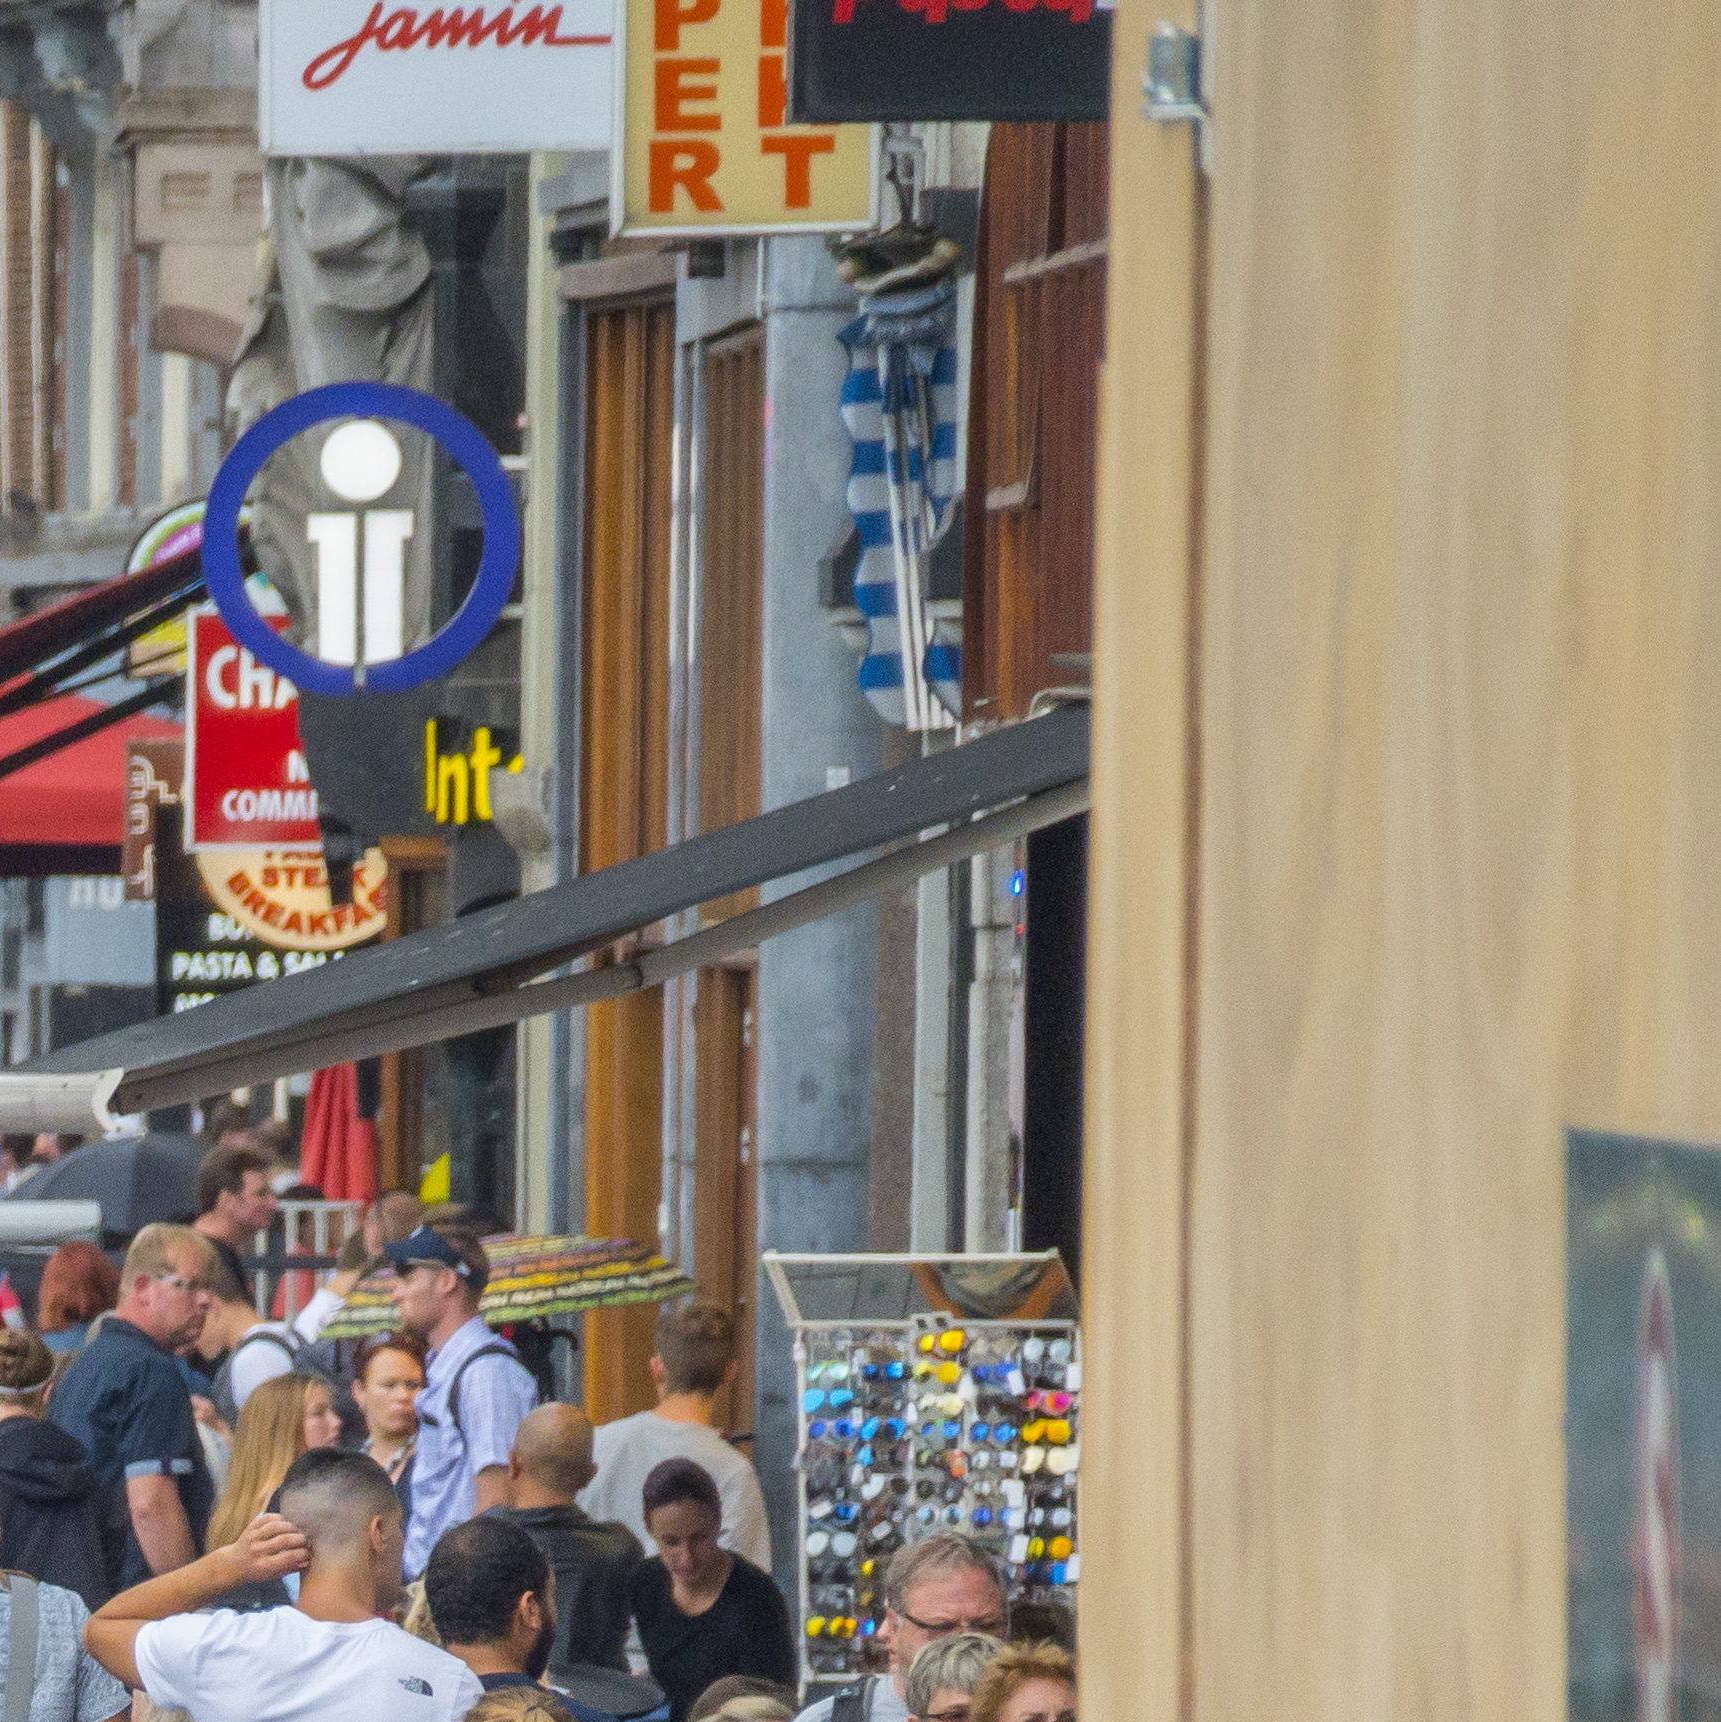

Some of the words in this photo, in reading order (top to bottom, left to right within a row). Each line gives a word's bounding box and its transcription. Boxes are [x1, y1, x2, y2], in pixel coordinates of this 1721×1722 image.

[206, 643, 300, 711] CHA
[425, 716, 507, 823] Int
[221, 788, 319, 822] COMMI
[171, 951, 253, 981] PASTA
